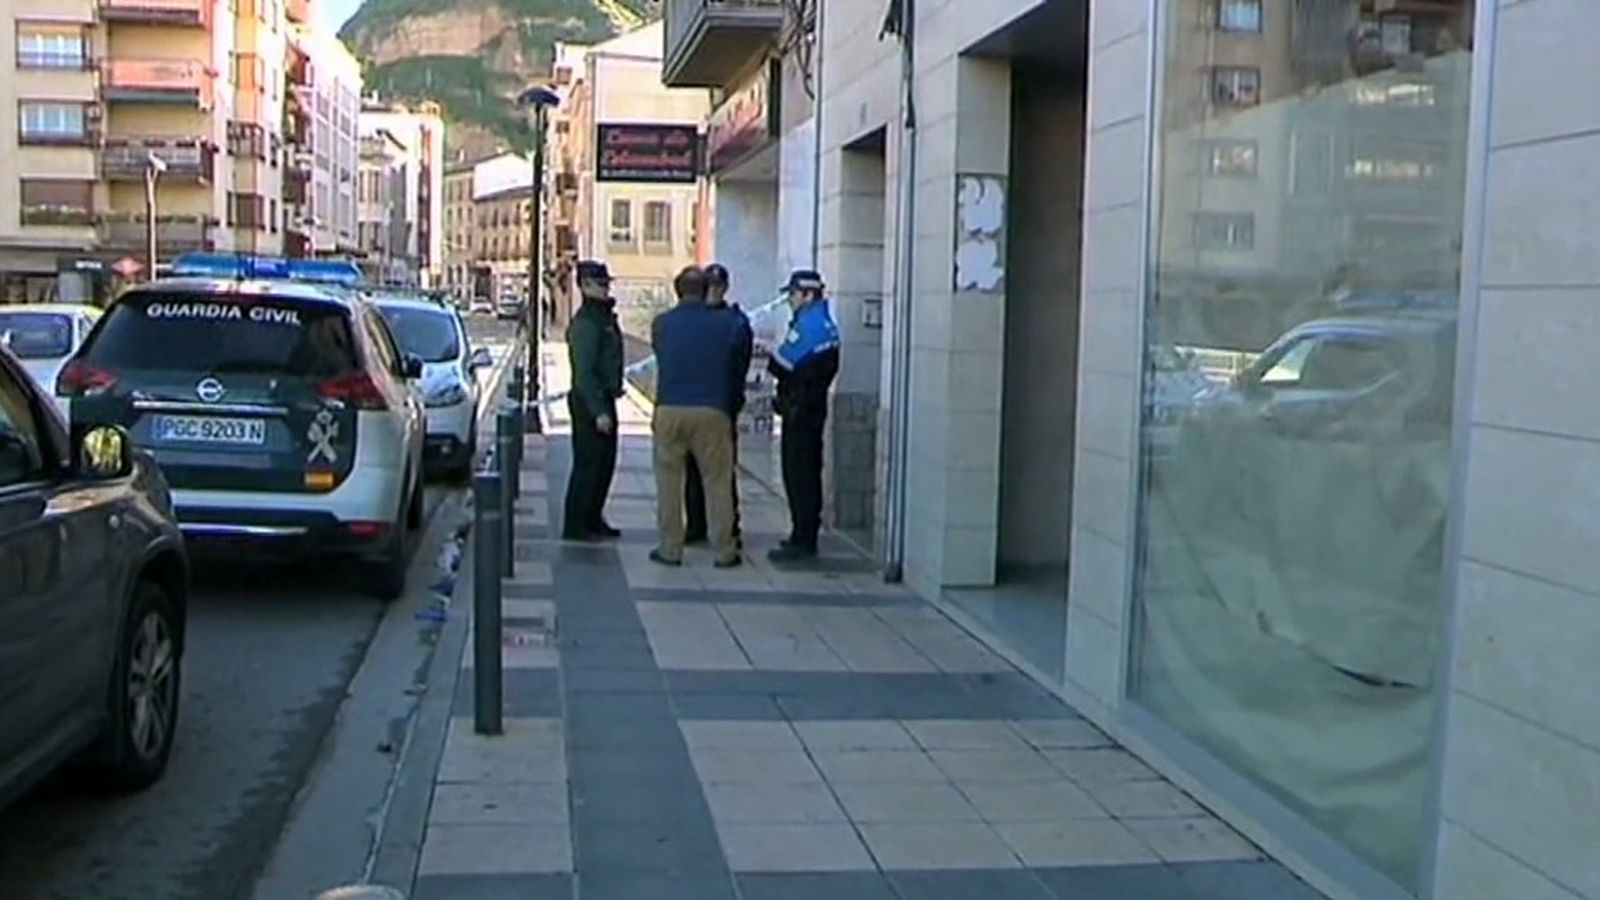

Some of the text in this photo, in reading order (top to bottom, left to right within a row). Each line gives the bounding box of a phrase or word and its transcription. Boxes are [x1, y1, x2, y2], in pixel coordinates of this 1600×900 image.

[147, 302, 302, 326] GUARDIA CIVIL
[163, 417, 262, 440] PGC 9203 N
